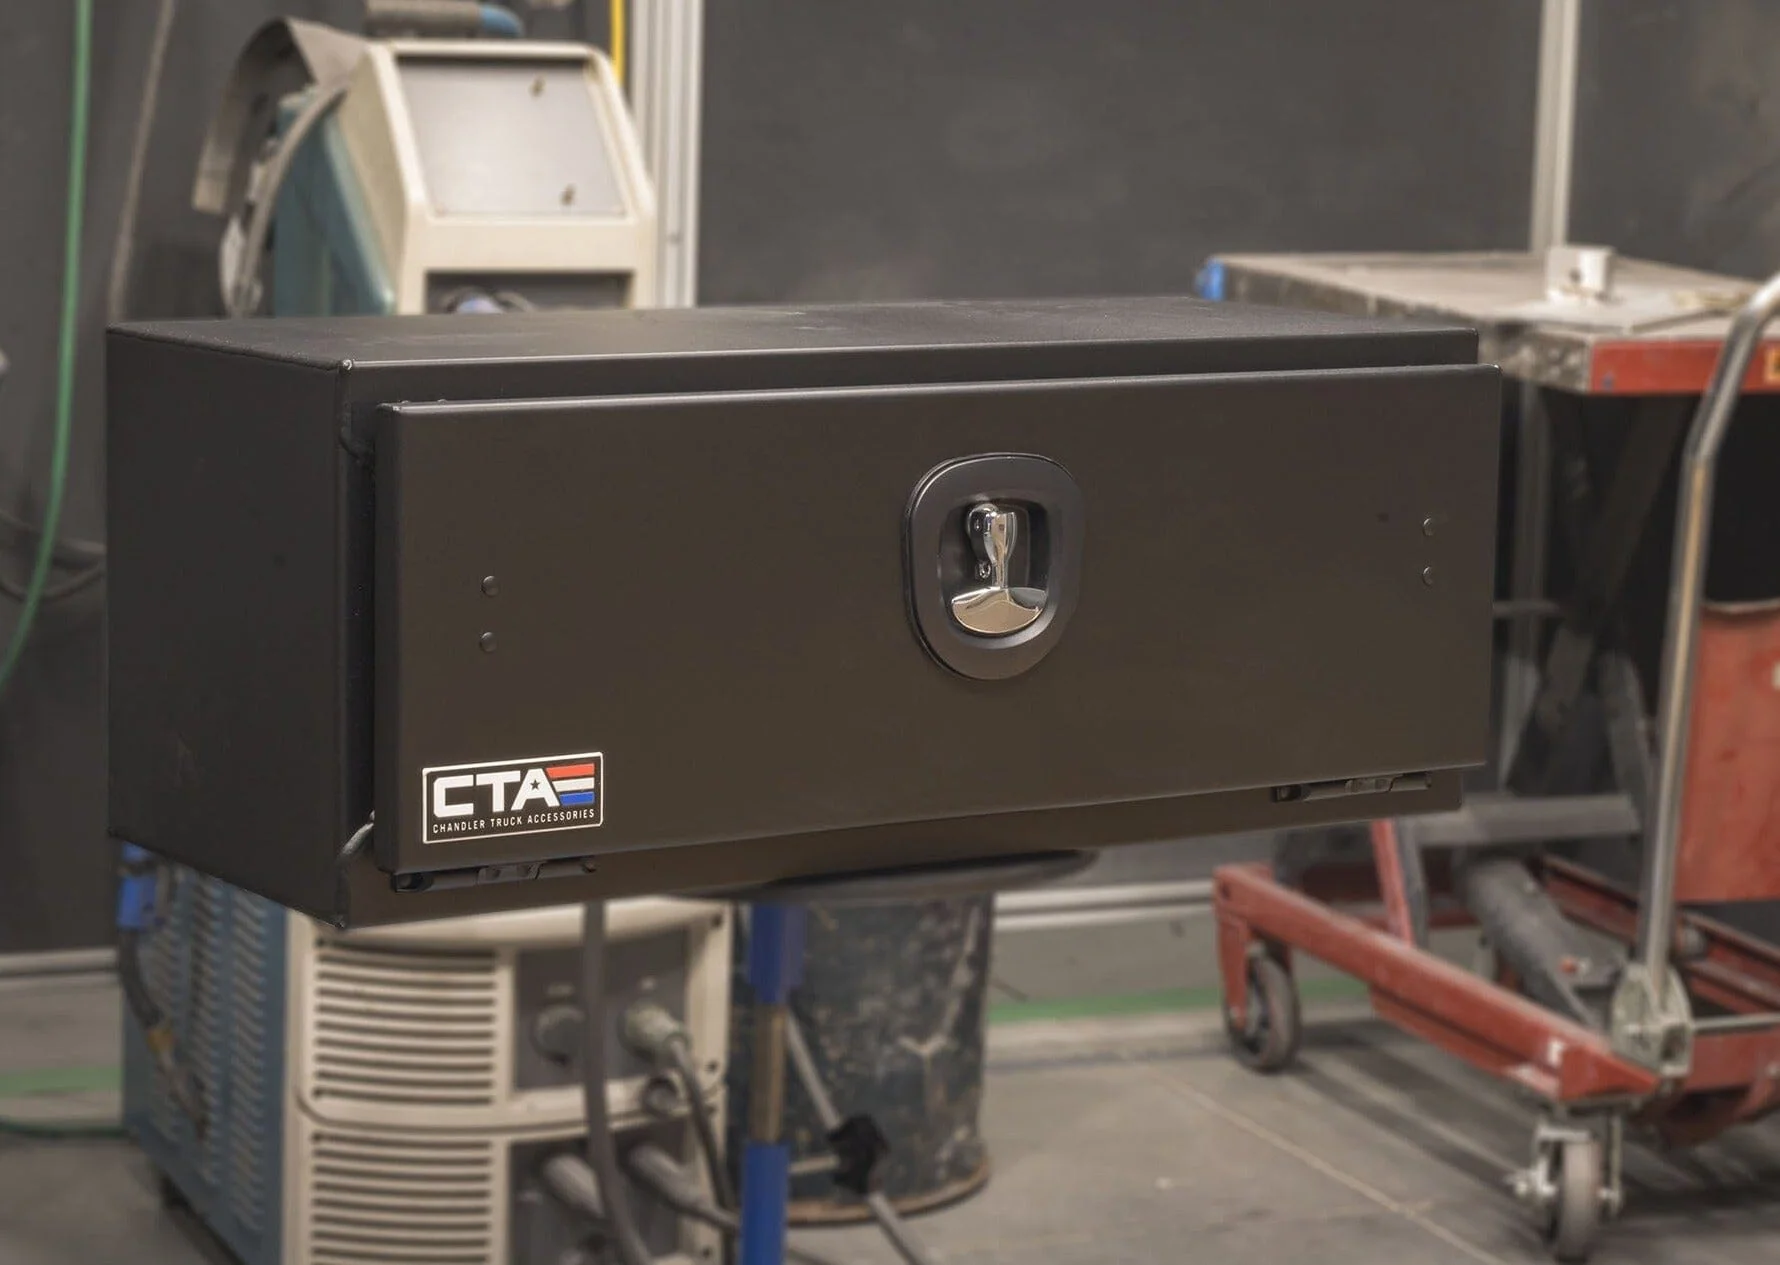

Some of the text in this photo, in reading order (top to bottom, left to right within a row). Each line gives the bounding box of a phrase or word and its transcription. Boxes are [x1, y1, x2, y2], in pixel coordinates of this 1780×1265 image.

[433, 768, 560, 818] CTA
[433, 808, 595, 834] CHANDLER TRUCK ACCESSORIES
